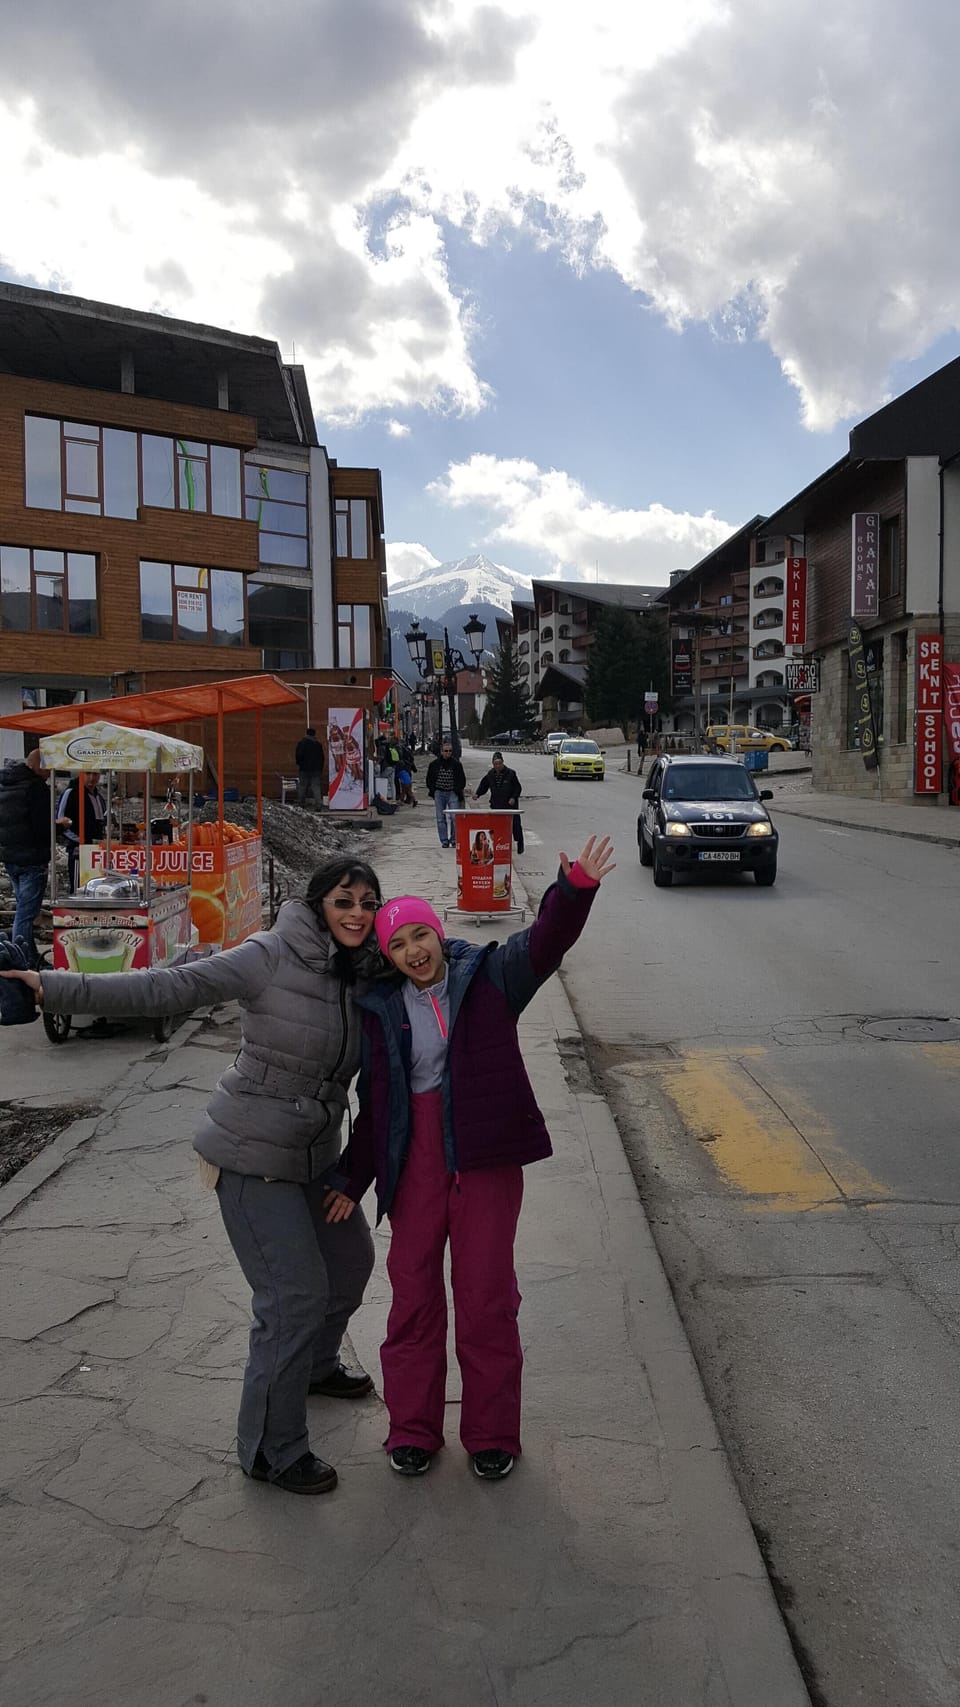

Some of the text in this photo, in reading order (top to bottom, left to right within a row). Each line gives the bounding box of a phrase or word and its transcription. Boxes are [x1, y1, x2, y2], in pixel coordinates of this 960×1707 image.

[865, 516, 876, 606] GRANAT
[791, 559, 800, 643] SKI RENT
[920, 642, 930, 704] SKI
[930, 642, 940, 704] RENT
[924, 715, 936, 789] SCHOOL
[91, 851, 152, 870] FRESH
[156, 851, 213, 871] JUICE
[60, 928, 143, 947] SWEET CORN
